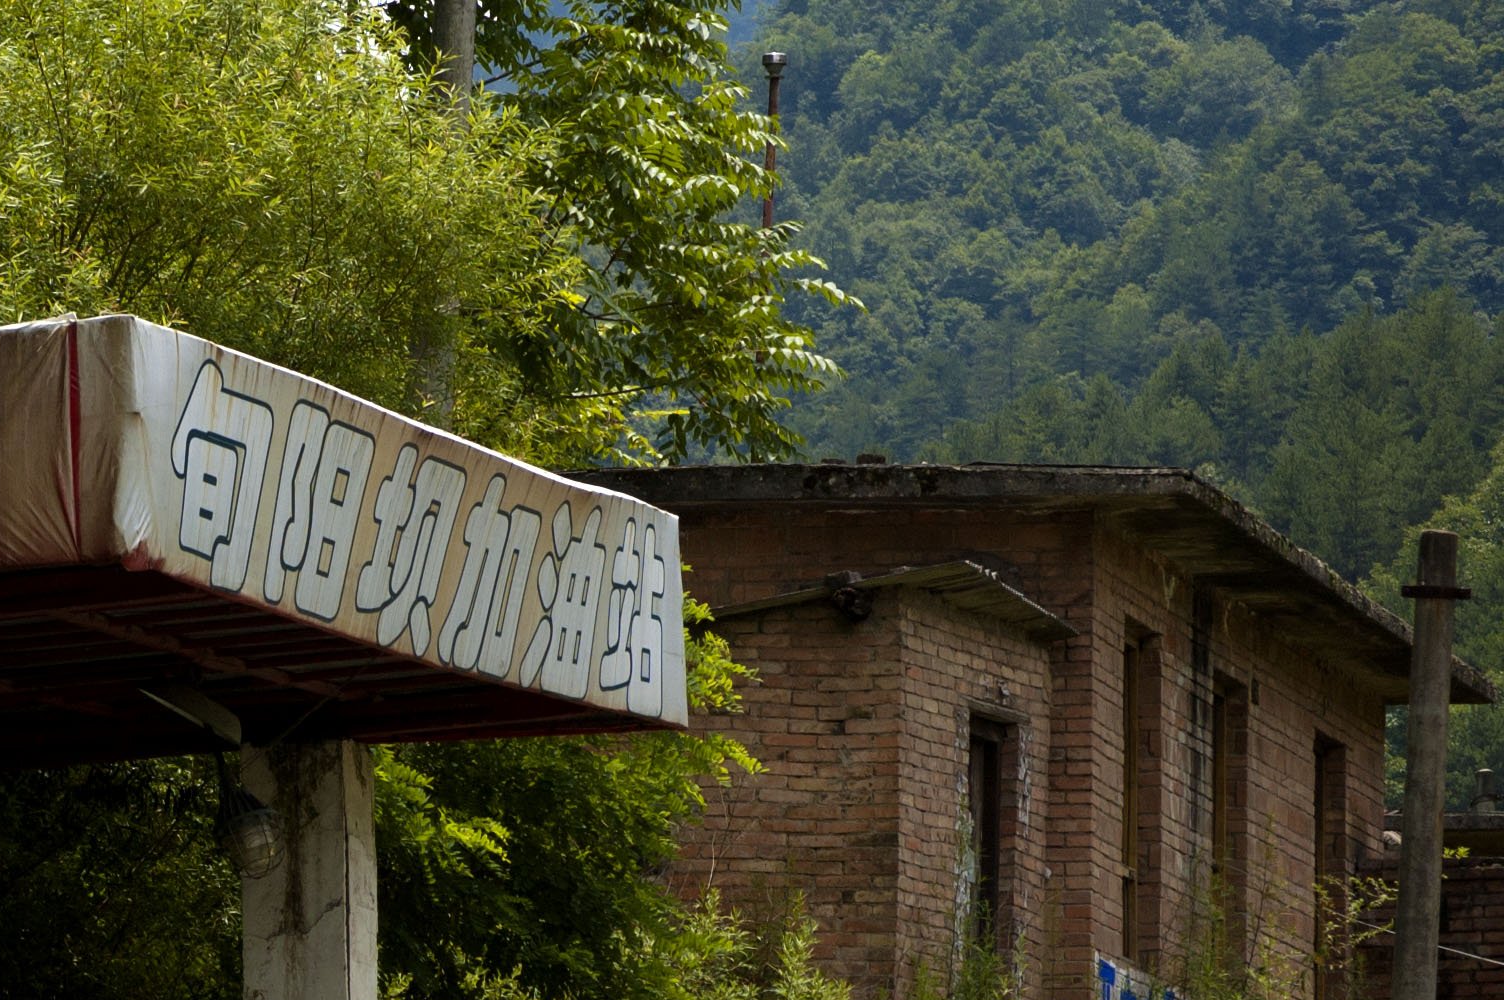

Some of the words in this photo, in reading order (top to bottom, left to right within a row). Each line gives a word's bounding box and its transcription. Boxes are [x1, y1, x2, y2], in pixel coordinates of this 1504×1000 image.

[170, 358, 665, 719] 旬阳坝加油站
